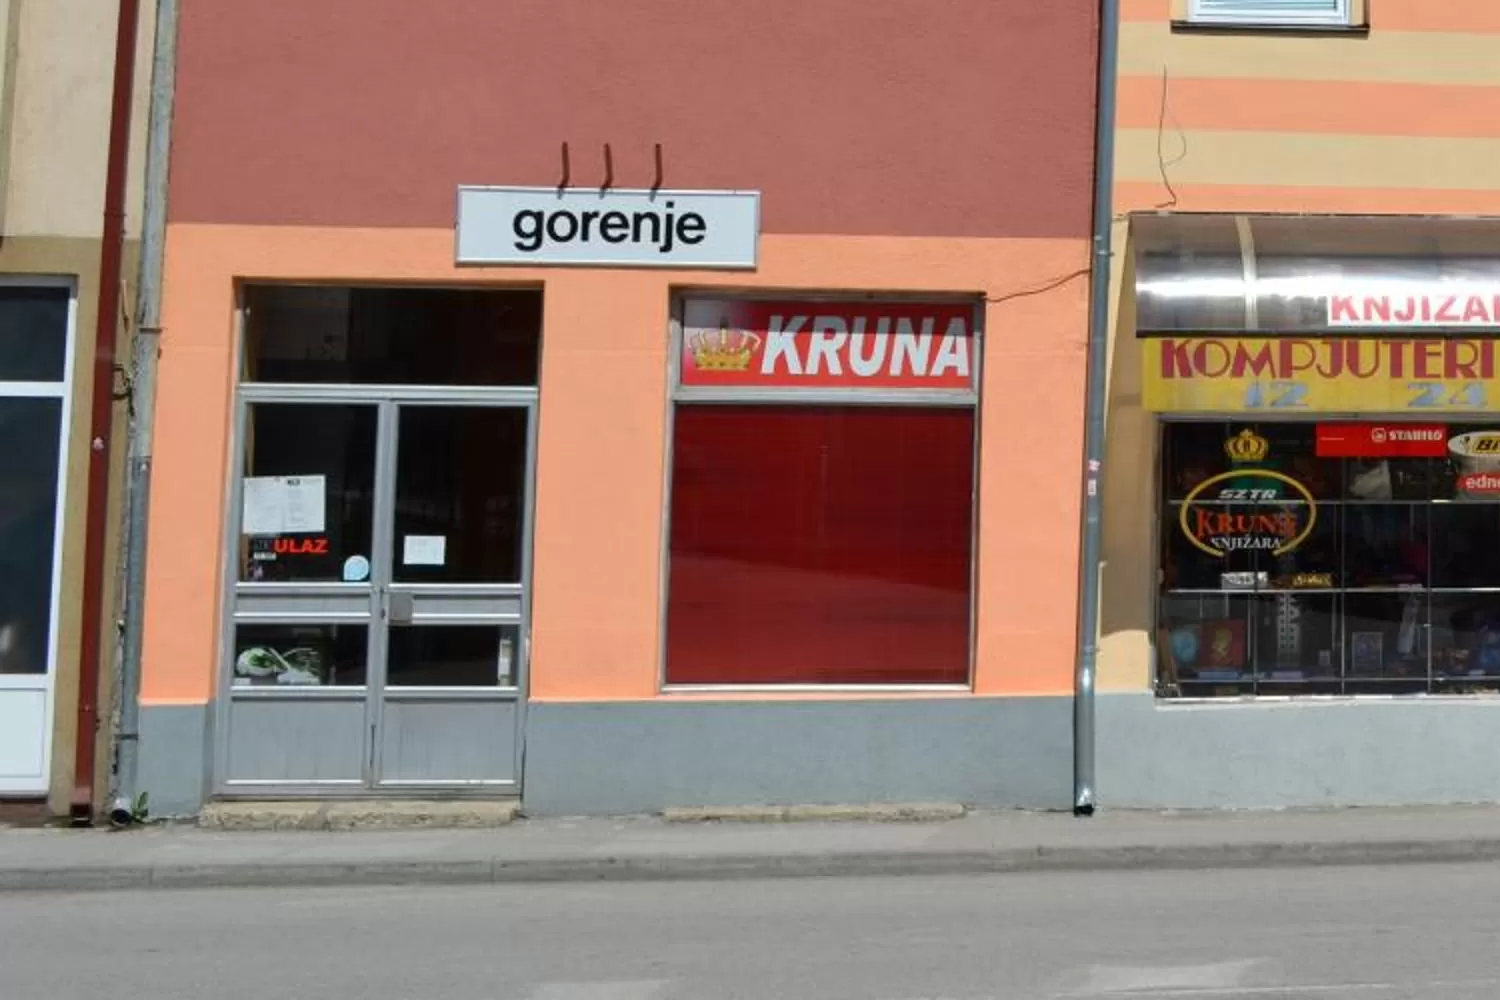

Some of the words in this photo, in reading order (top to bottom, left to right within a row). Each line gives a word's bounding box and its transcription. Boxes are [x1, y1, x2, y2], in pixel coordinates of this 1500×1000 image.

[513, 201, 706, 253] gorenje
[760, 315, 970, 377] KRUNA
[1161, 338, 1494, 379] KOMPJUTERI
[1243, 382, 1310, 407] 12
[1407, 382, 1488, 408] 24
[273, 538, 328, 553] ULAZ
